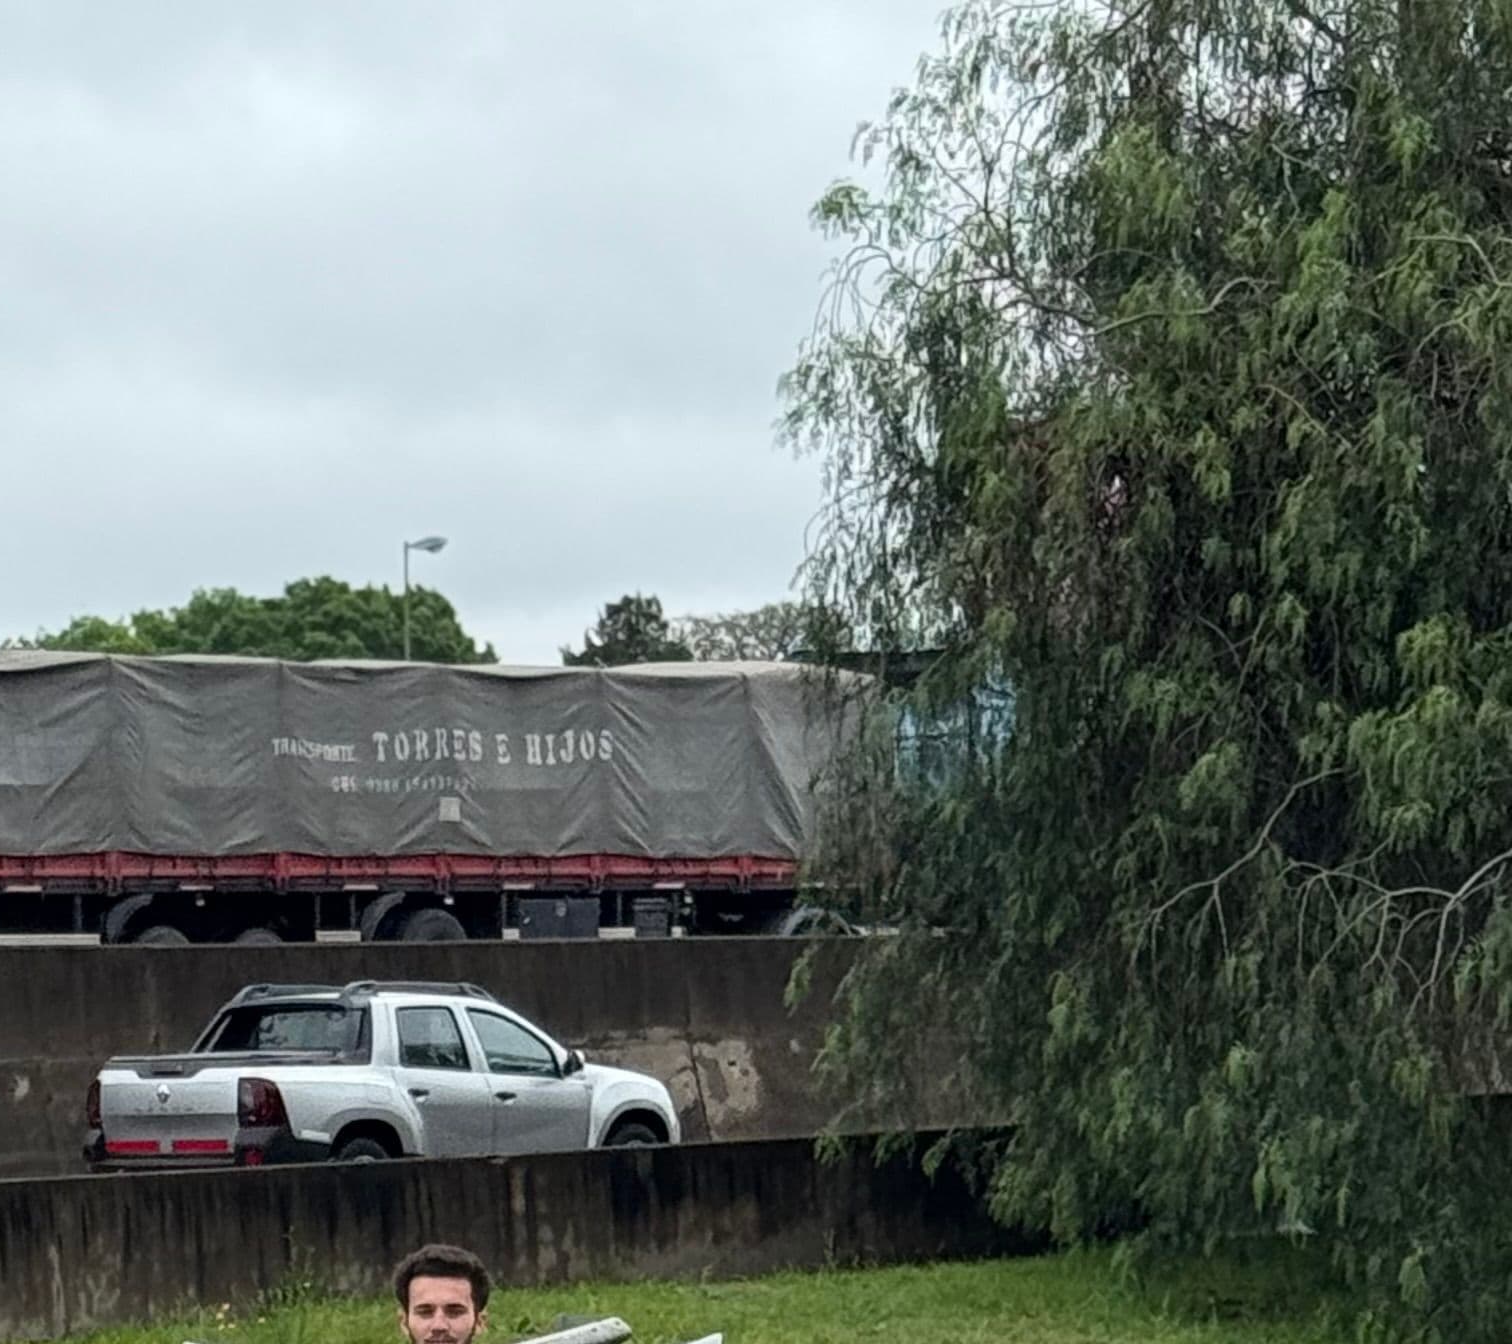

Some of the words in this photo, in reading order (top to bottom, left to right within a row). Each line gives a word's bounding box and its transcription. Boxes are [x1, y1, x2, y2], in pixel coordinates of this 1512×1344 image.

[372, 728, 483, 762] TORRES
[496, 733, 511, 764] E
[524, 729, 614, 765] HIJOS
